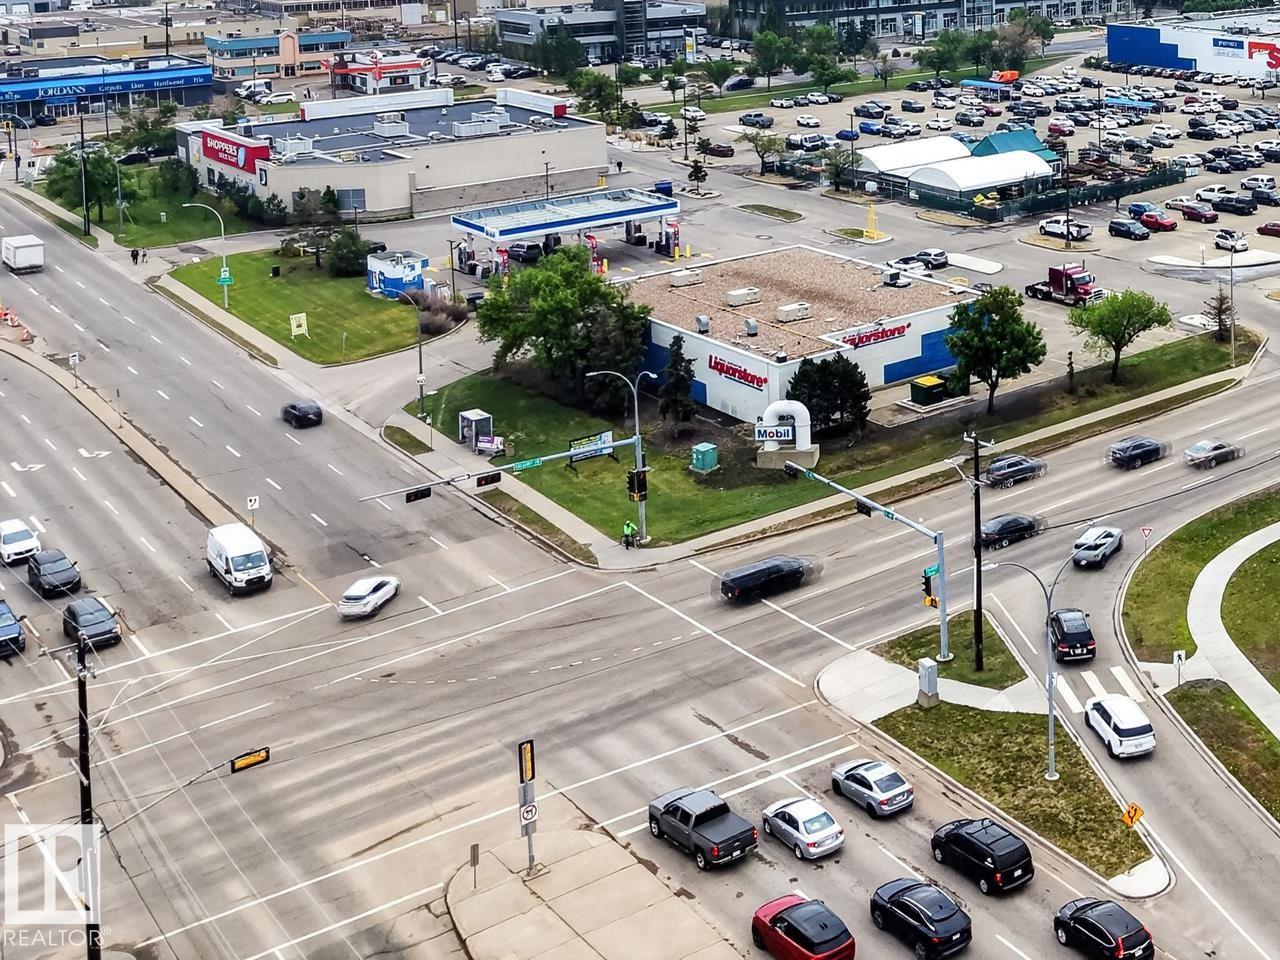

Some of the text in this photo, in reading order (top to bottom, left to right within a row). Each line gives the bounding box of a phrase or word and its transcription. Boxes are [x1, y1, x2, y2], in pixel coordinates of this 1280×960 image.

[36, 85, 86, 99] JORDANS
[708, 354, 764, 388] Liquorstore
[757, 428, 790, 439] Mobil
